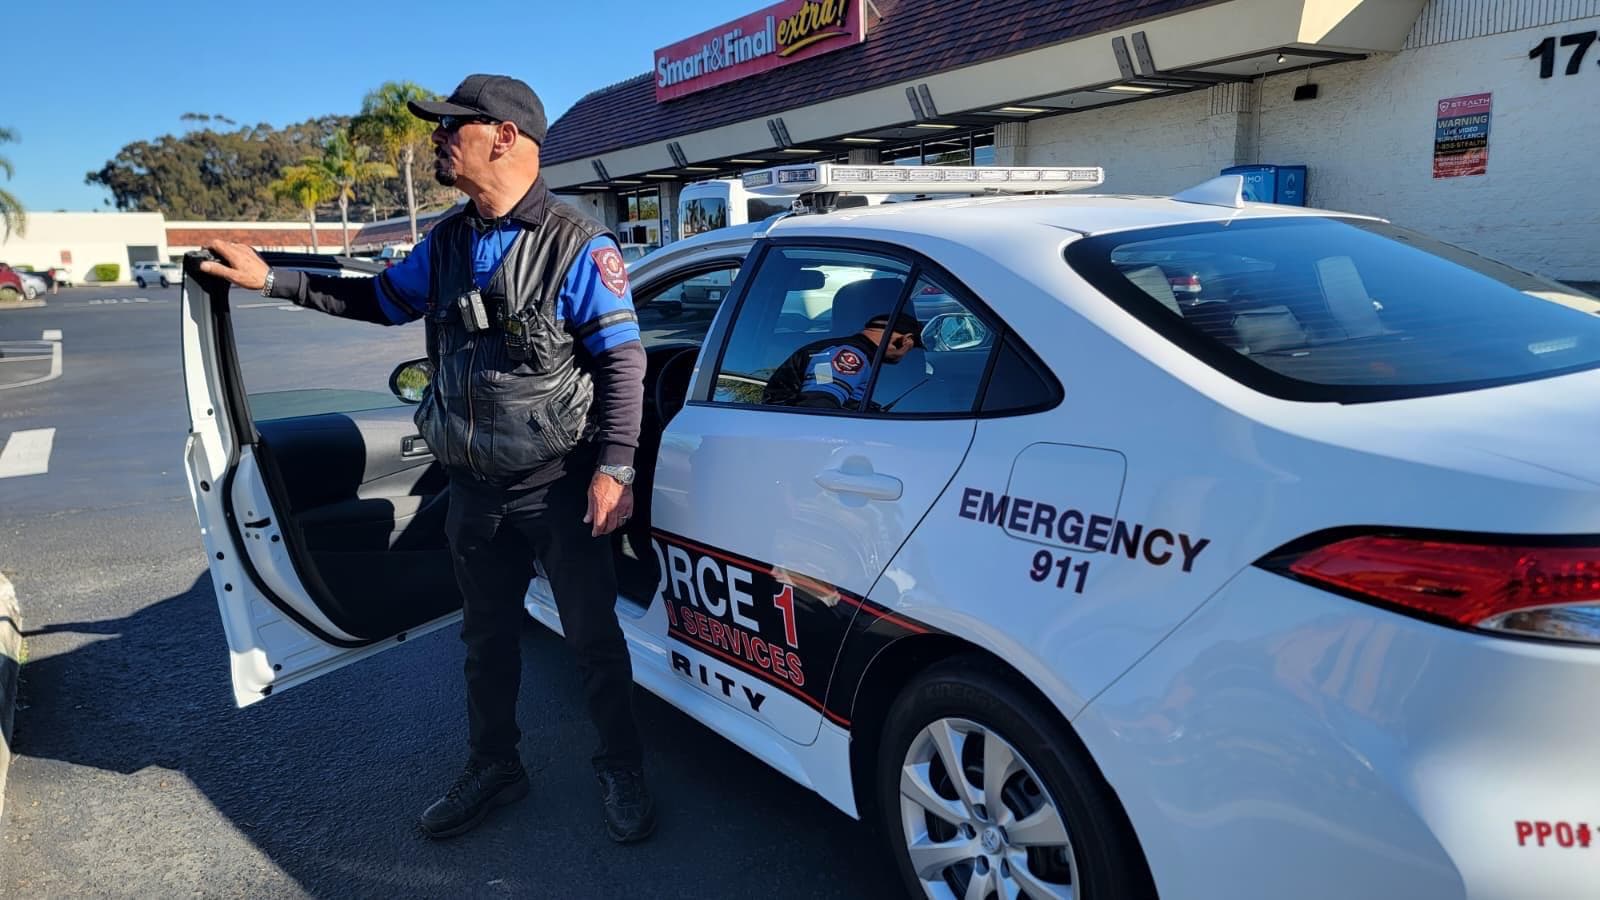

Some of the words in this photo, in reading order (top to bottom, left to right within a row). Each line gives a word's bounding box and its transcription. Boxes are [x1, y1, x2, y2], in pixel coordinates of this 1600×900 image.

[657, 16, 776, 88] Smart&Final
[776, 0, 846, 45] extra!
[1528, 30, 1600, 79] 17
[1437, 115, 1488, 129] WARNING
[1450, 98, 1490, 108] STEALTH
[1437, 132, 1485, 143] SURVEILLANCE
[1443, 127, 1458, 136] LIVE
[1458, 126, 1479, 134] VIDEO
[958, 486, 1211, 574] EMERGENCY
[1029, 549, 1090, 595] 911
[773, 583, 799, 650] 1
[680, 606, 805, 687] SERVICES
[671, 650, 767, 713] RITY
